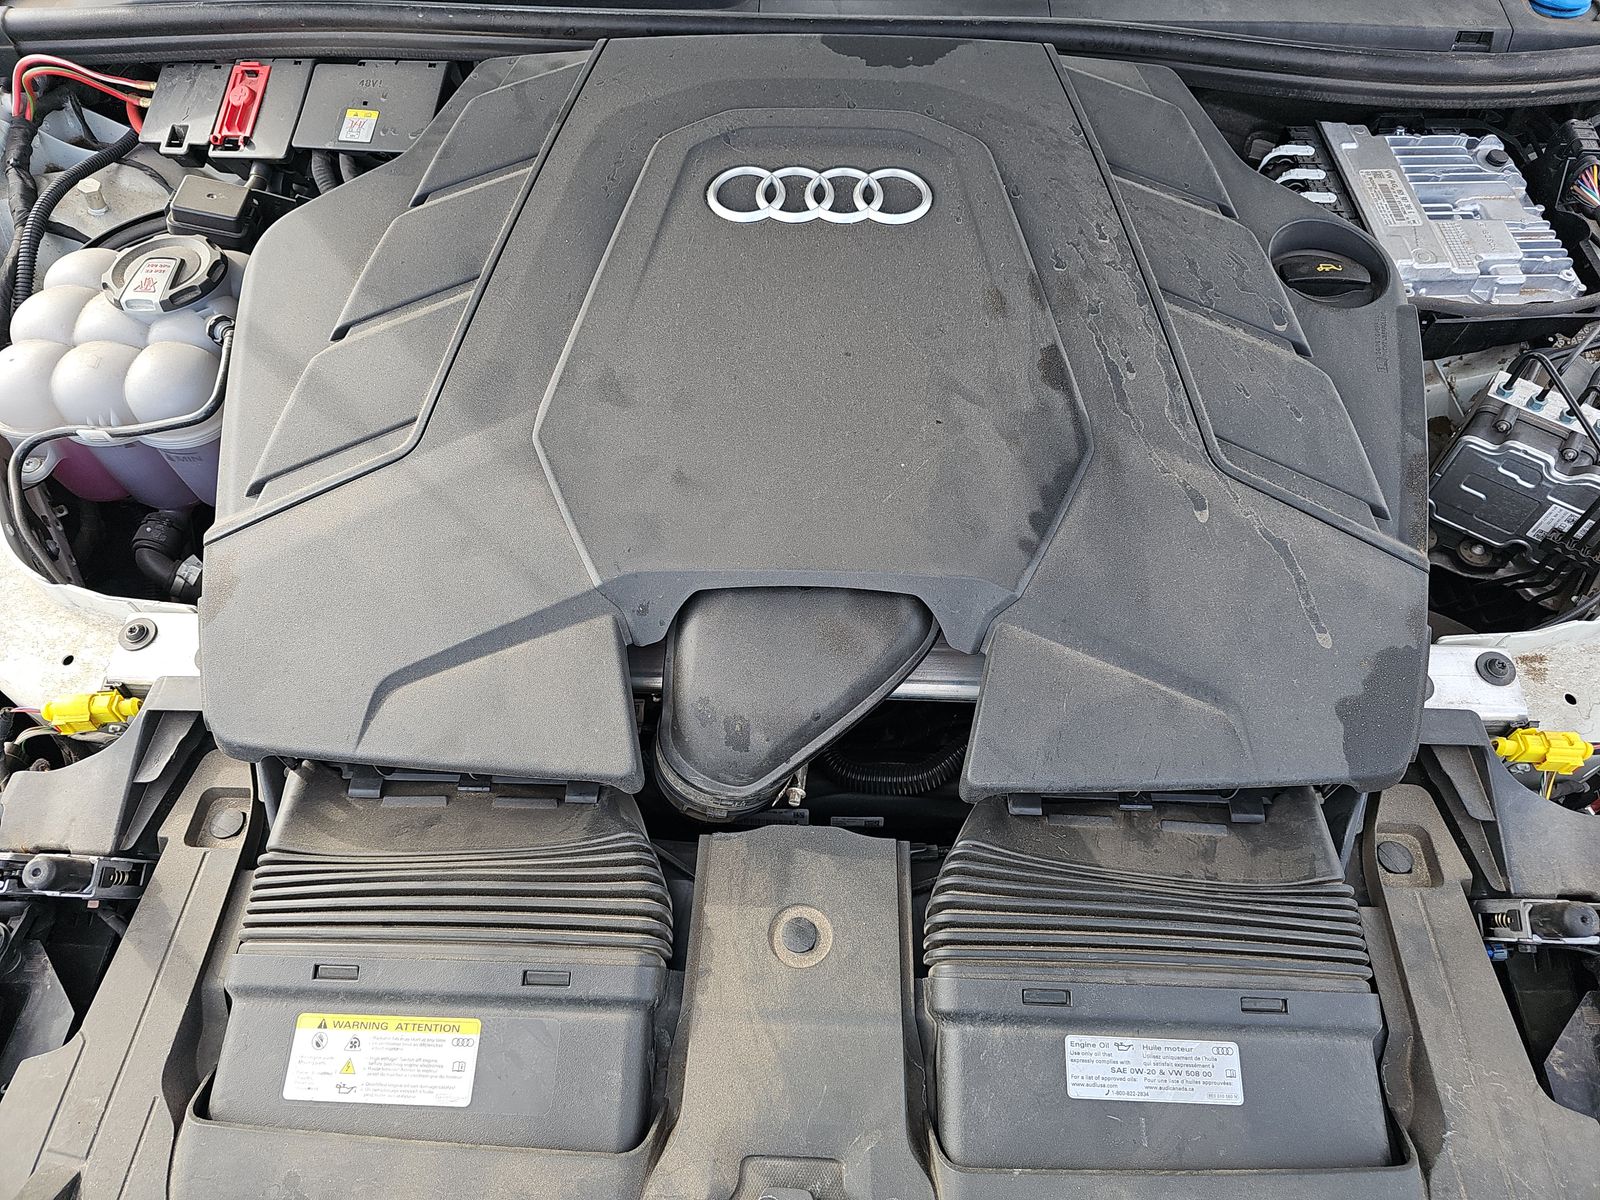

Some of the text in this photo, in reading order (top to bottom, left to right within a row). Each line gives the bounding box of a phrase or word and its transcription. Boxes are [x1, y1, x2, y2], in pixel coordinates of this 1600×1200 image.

[359, 79, 382, 88] 48V!
[332, 1020, 460, 1033] WARNING ATTENTION
[1070, 1041, 1096, 1049] Engine
[1130, 1068, 1156, 1076] 0W-20
[1158, 1068, 1165, 1076] &
[1202, 1070, 1213, 1078] 00
[1144, 1084, 1195, 1092] www.audicanada.ca
